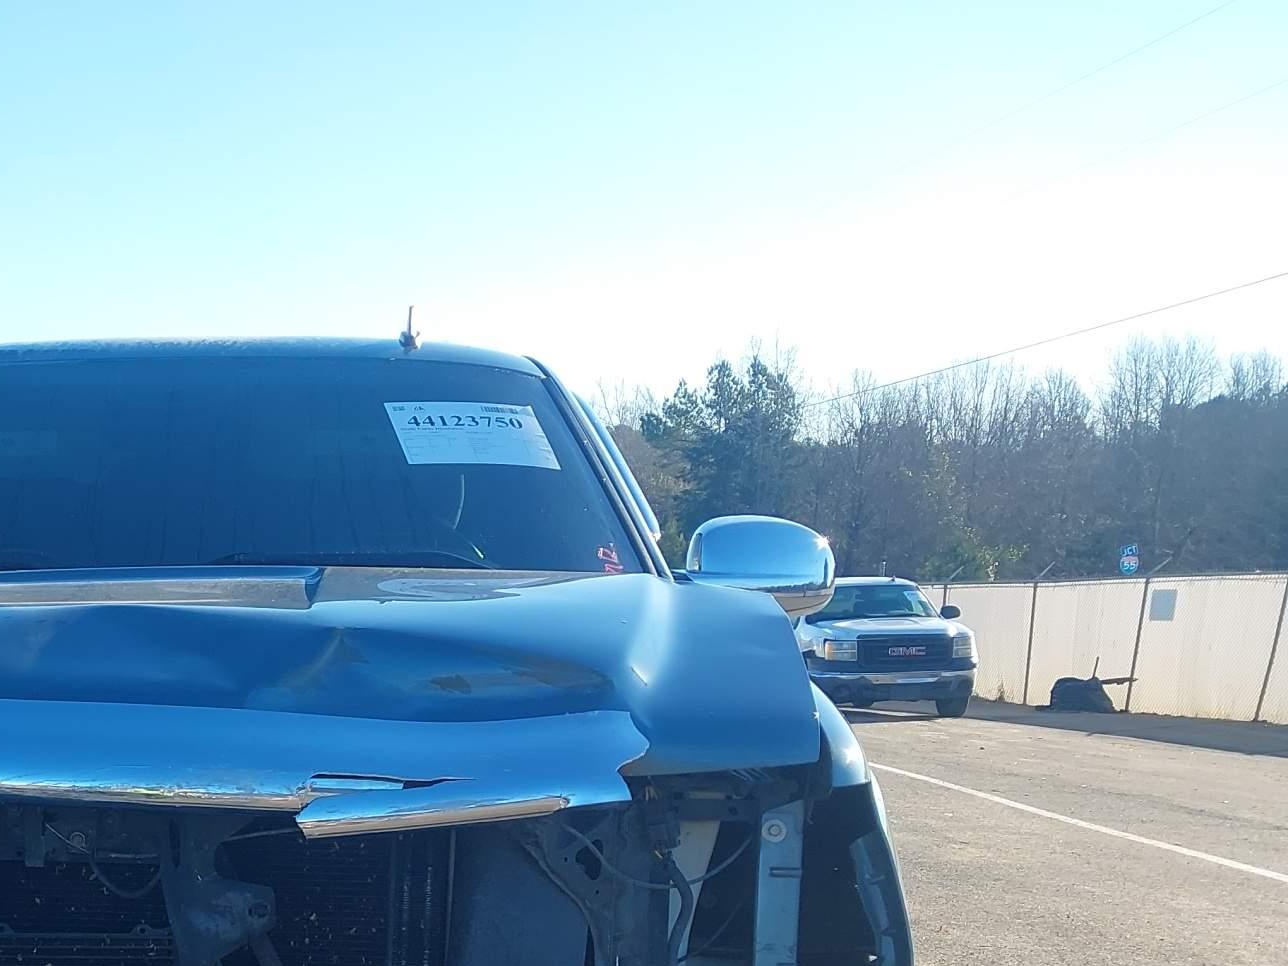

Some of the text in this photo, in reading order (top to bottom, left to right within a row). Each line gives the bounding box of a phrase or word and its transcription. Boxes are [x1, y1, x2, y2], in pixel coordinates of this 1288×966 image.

[407, 415, 523, 430] 44123750
[1122, 546, 1137, 556] JCT
[1123, 561, 1136, 570] 55
[888, 646, 926, 655] GMC
